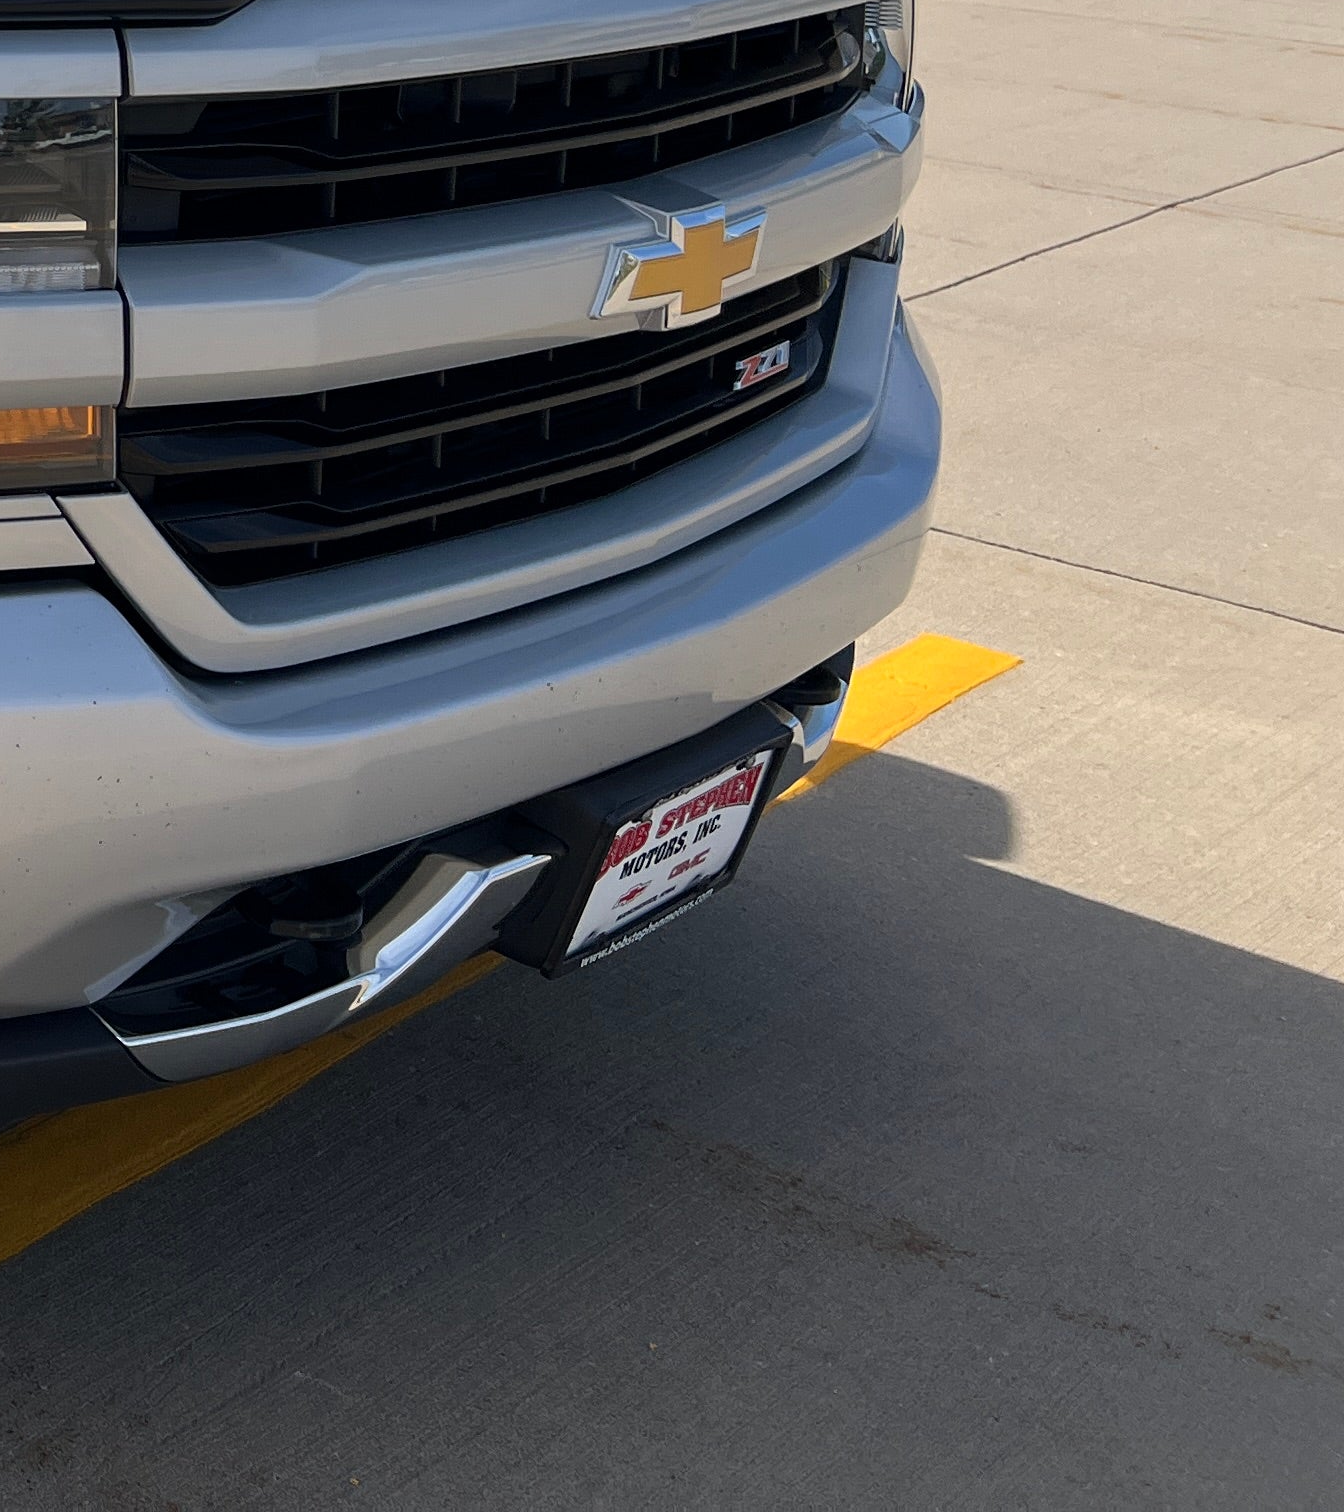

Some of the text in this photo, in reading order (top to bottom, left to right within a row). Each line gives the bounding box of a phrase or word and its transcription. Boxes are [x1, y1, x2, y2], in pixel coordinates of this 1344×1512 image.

[732, 339, 791, 391] Z71
[597, 762, 765, 883] BOB STEPHEN
[618, 813, 722, 881] MOTORS, INC.
